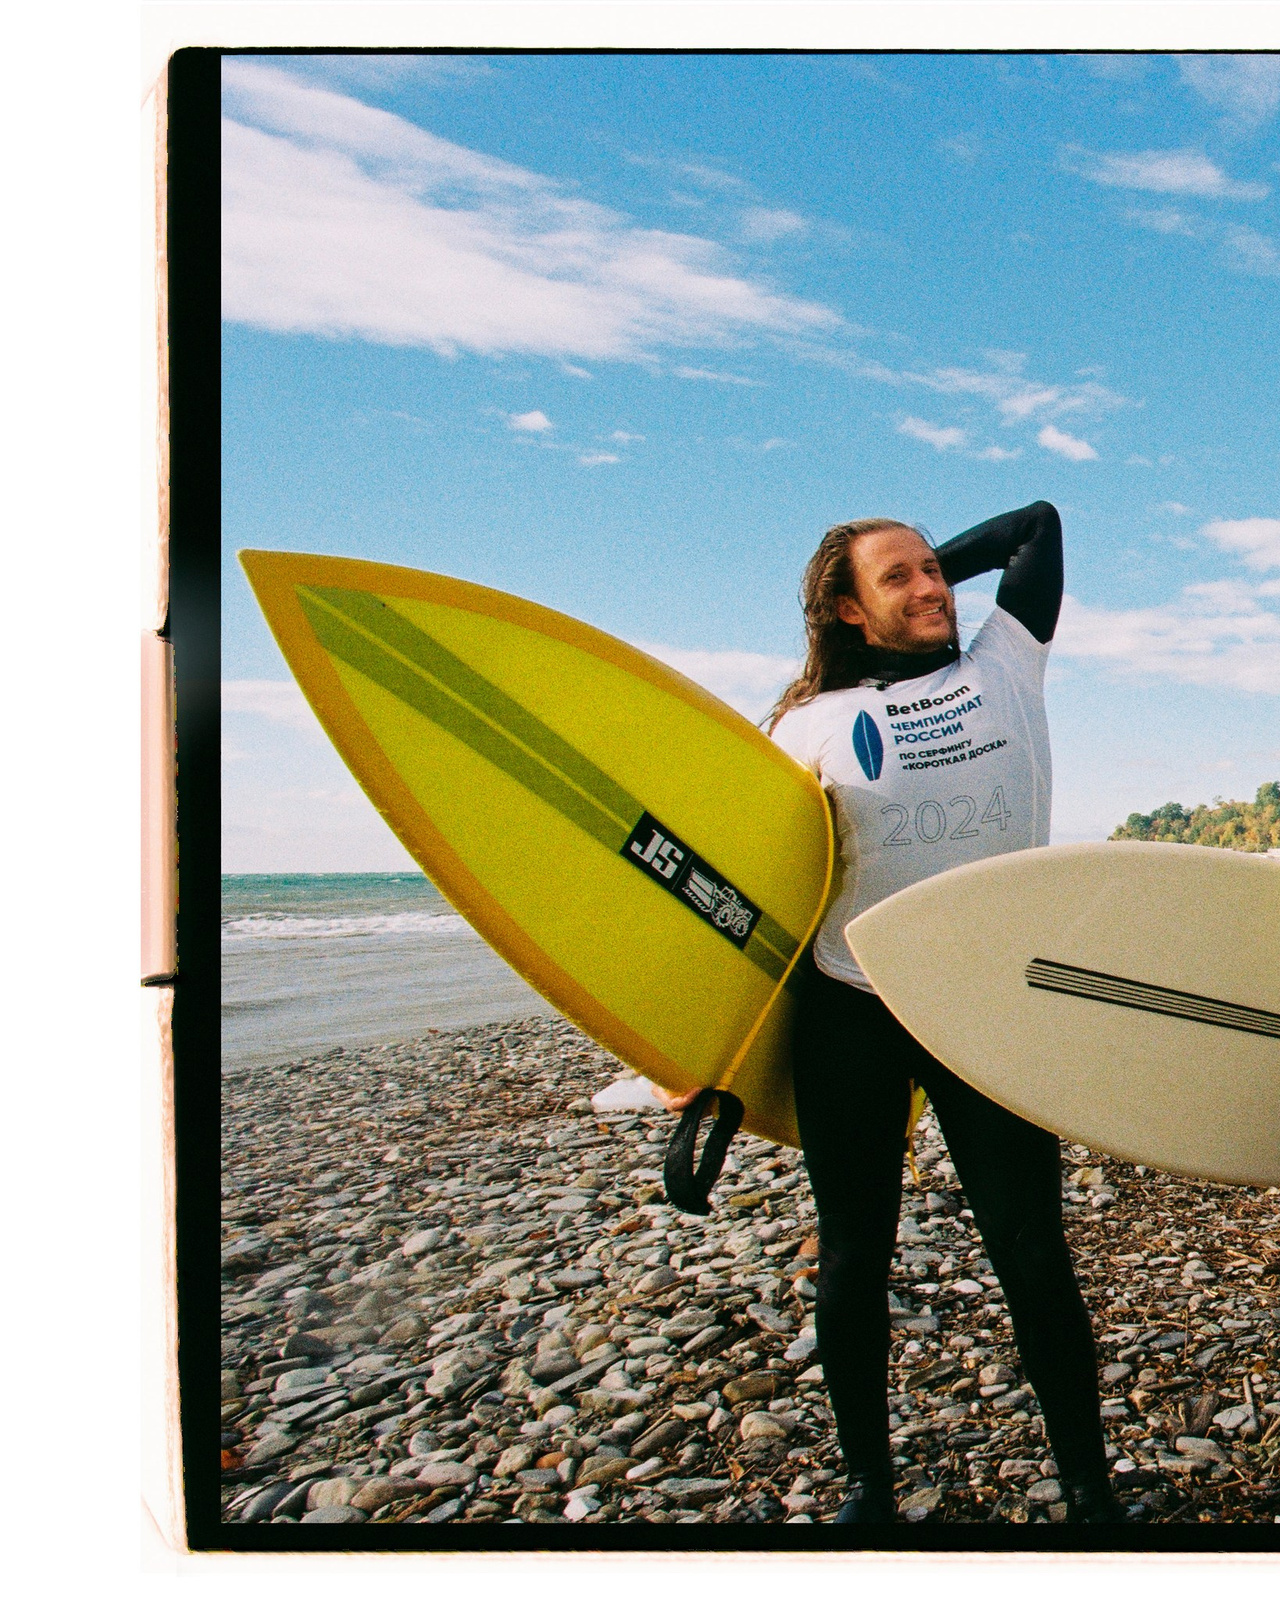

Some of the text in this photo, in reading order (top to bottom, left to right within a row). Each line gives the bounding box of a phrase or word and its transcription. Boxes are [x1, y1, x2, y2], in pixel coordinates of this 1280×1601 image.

[886, 683, 971, 717] BetBoom
[890, 694, 983, 732] ЧЕМПИОНАТ
[893, 721, 964, 745] РОССИИ
[899, 738, 973, 761] ПО СЕРФИНГУ
[902, 739, 1008, 771] «КОРОТКАЯ ДОСКА»
[881, 785, 1012, 847] 2024
[630, 829, 685, 880] JS
